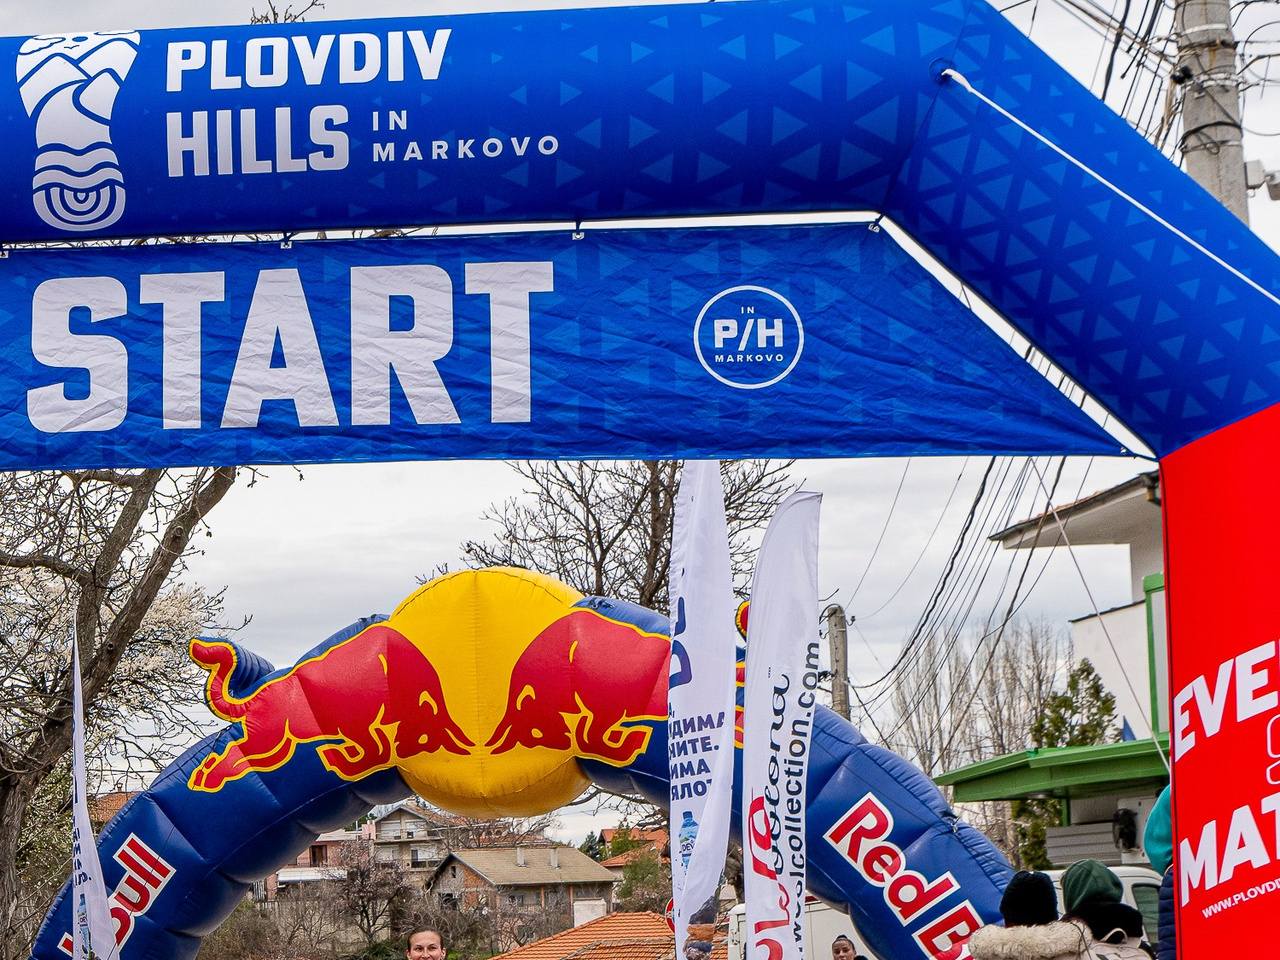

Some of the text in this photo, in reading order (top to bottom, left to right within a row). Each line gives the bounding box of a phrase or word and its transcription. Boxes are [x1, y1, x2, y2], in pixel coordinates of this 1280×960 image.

[165, 28, 452, 93] PLOVDIV
[372, 109, 408, 132] IN
[167, 103, 350, 178] HILLS
[372, 134, 560, 163] MARKOVO
[741, 306, 754, 314] IN
[26, 260, 555, 434] START
[713, 318, 783, 351] P/H
[714, 354, 784, 363] MARKOVO
[669, 711, 725, 740] ДИМА
[827, 796, 956, 922] Red
